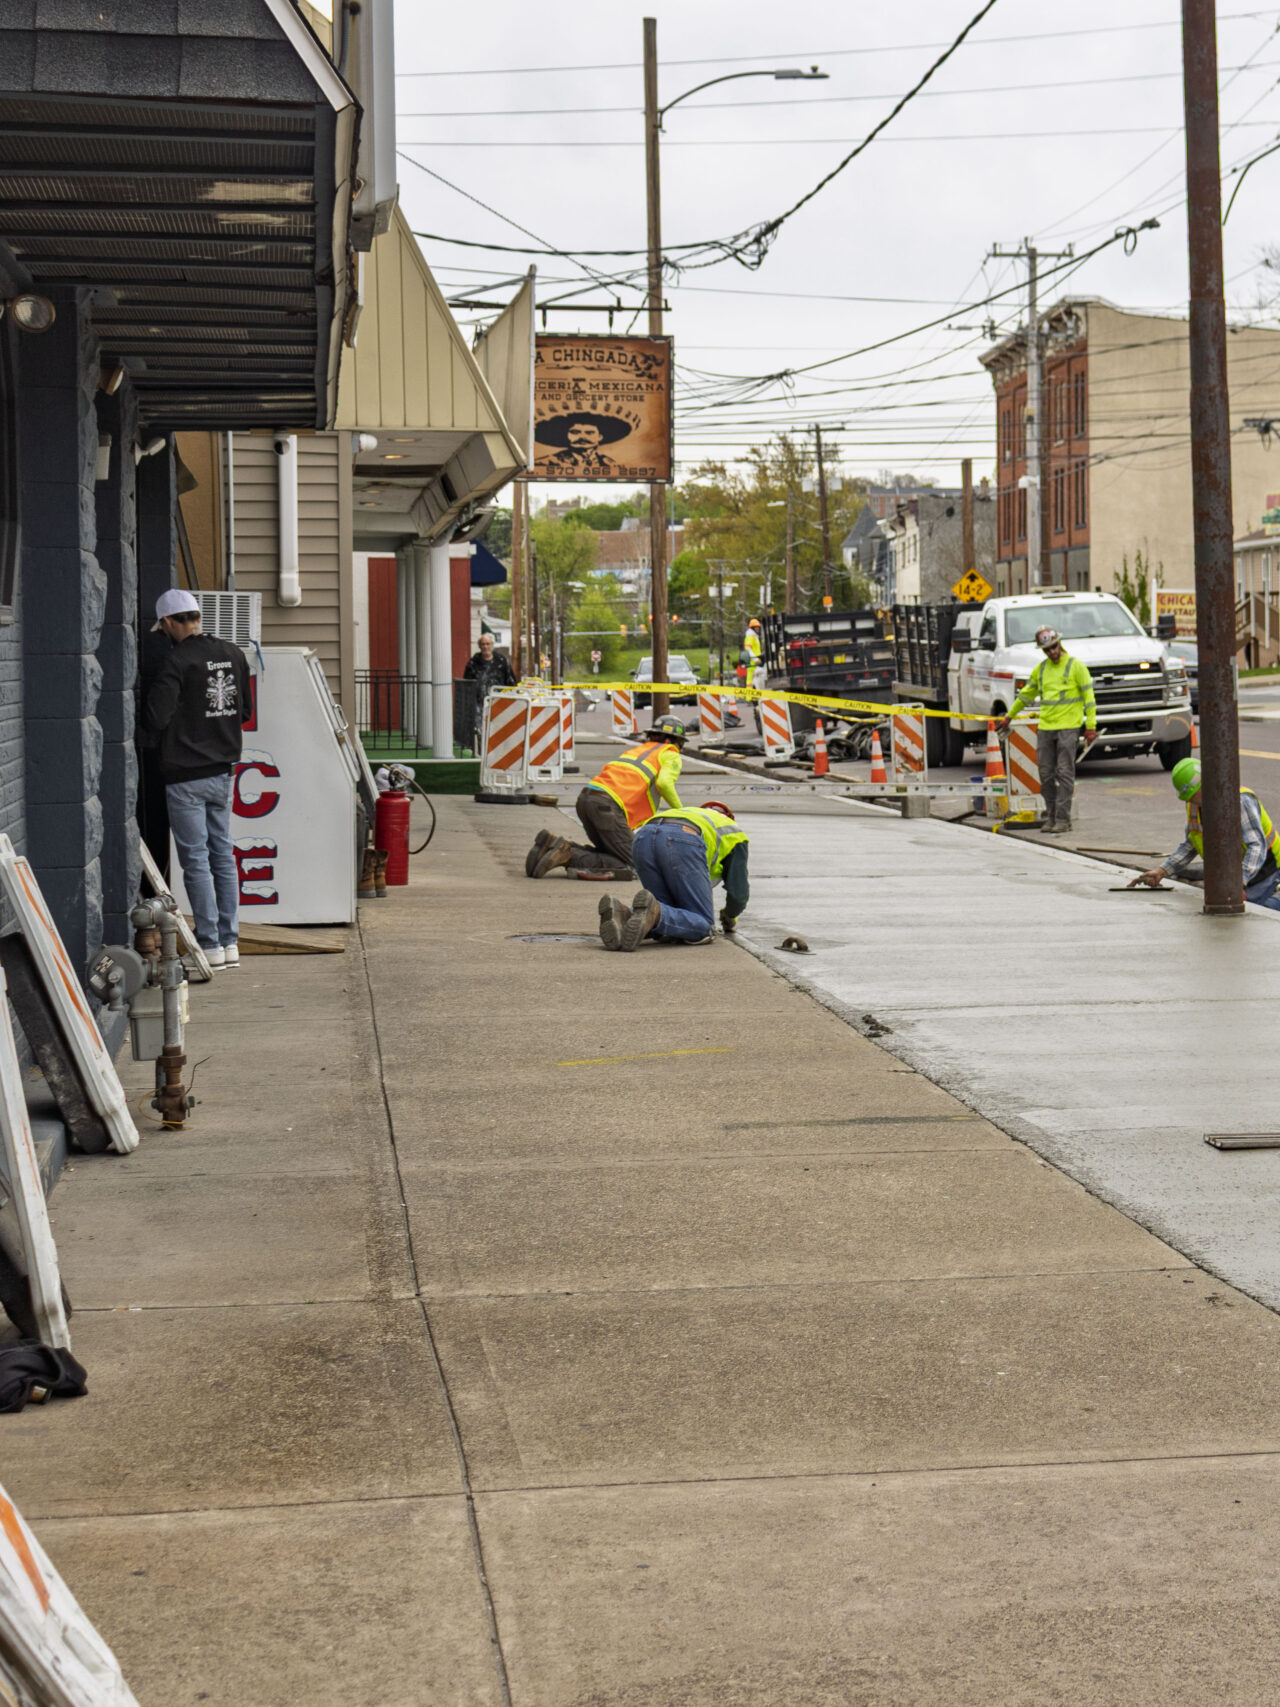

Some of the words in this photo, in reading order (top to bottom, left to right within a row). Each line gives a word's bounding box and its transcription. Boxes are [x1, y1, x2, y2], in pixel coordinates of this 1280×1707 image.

[553, 349, 639, 366] CHINGADA
[535, 382, 582, 391] CERIA
[589, 382, 665, 391] MEXICANA
[541, 393, 562, 401] AND
[613, 393, 645, 402] STORE
[207, 661, 232, 670] Groove
[679, 684, 707, 692] CAUTION
[734, 688, 762, 697] CAUTION
[789, 694, 817, 703] CAUTION
[844, 701, 872, 710] CAUTION
